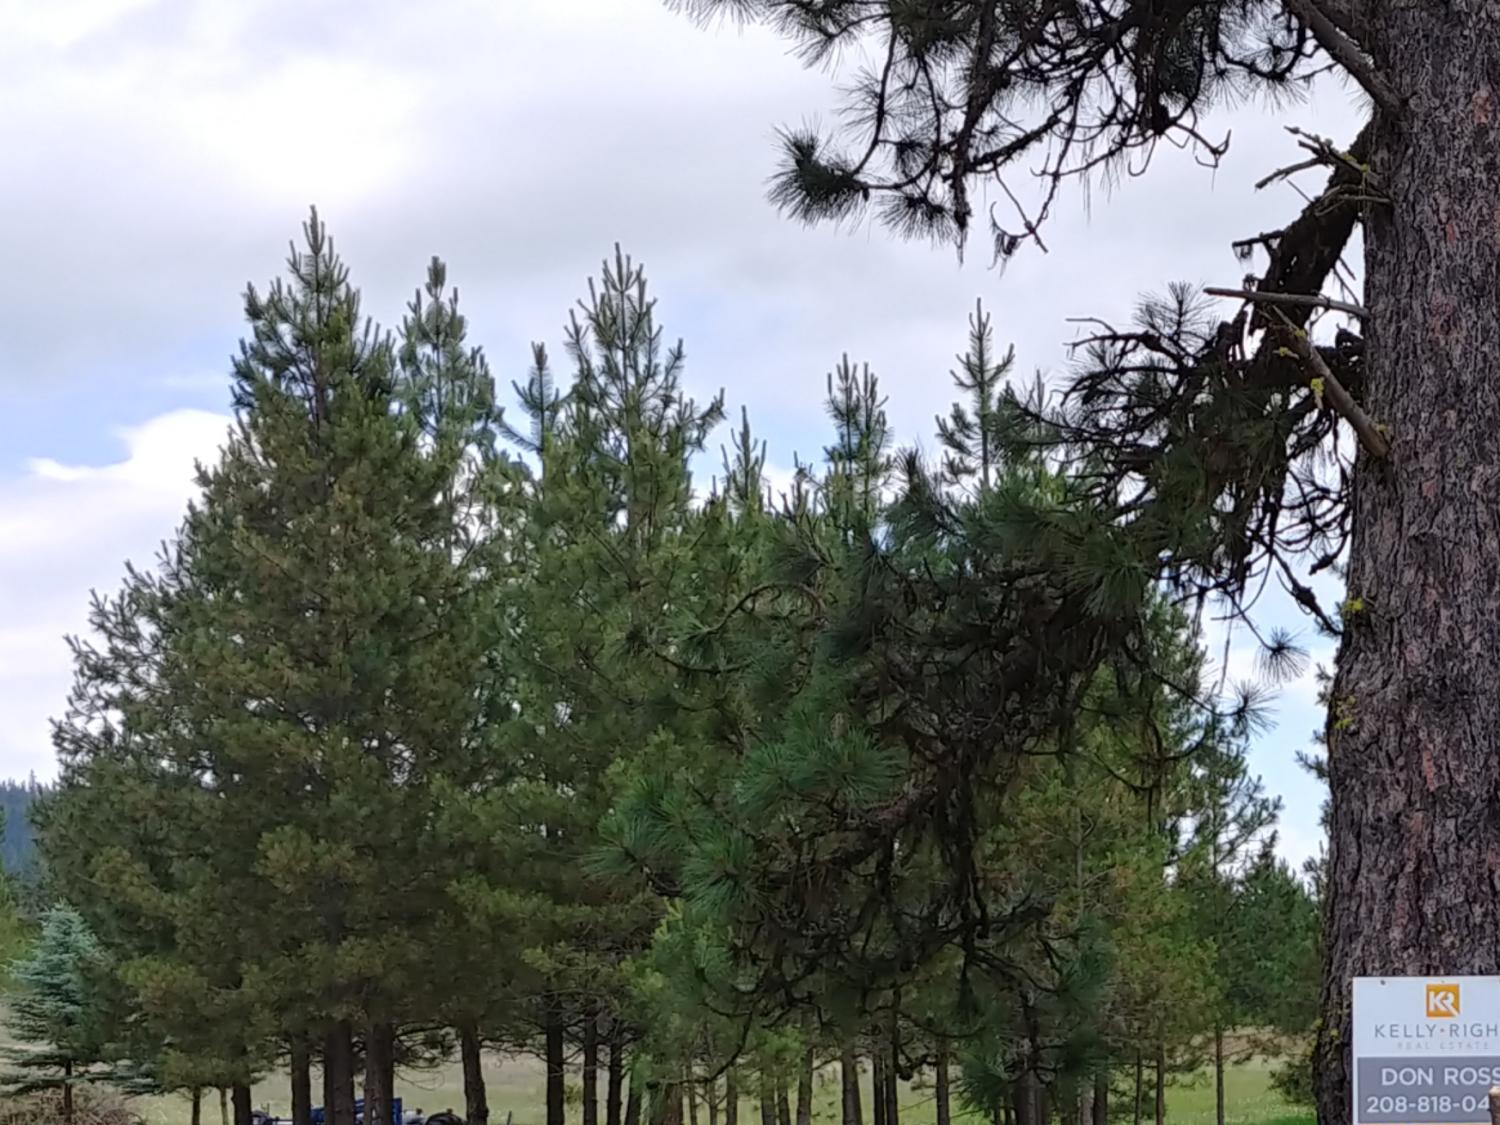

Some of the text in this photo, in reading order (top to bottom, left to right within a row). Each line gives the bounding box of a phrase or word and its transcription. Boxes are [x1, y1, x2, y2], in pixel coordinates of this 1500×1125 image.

[1397, 1041, 1489, 1050] REAL ESTATE
[1381, 1067, 1433, 1086] DON
